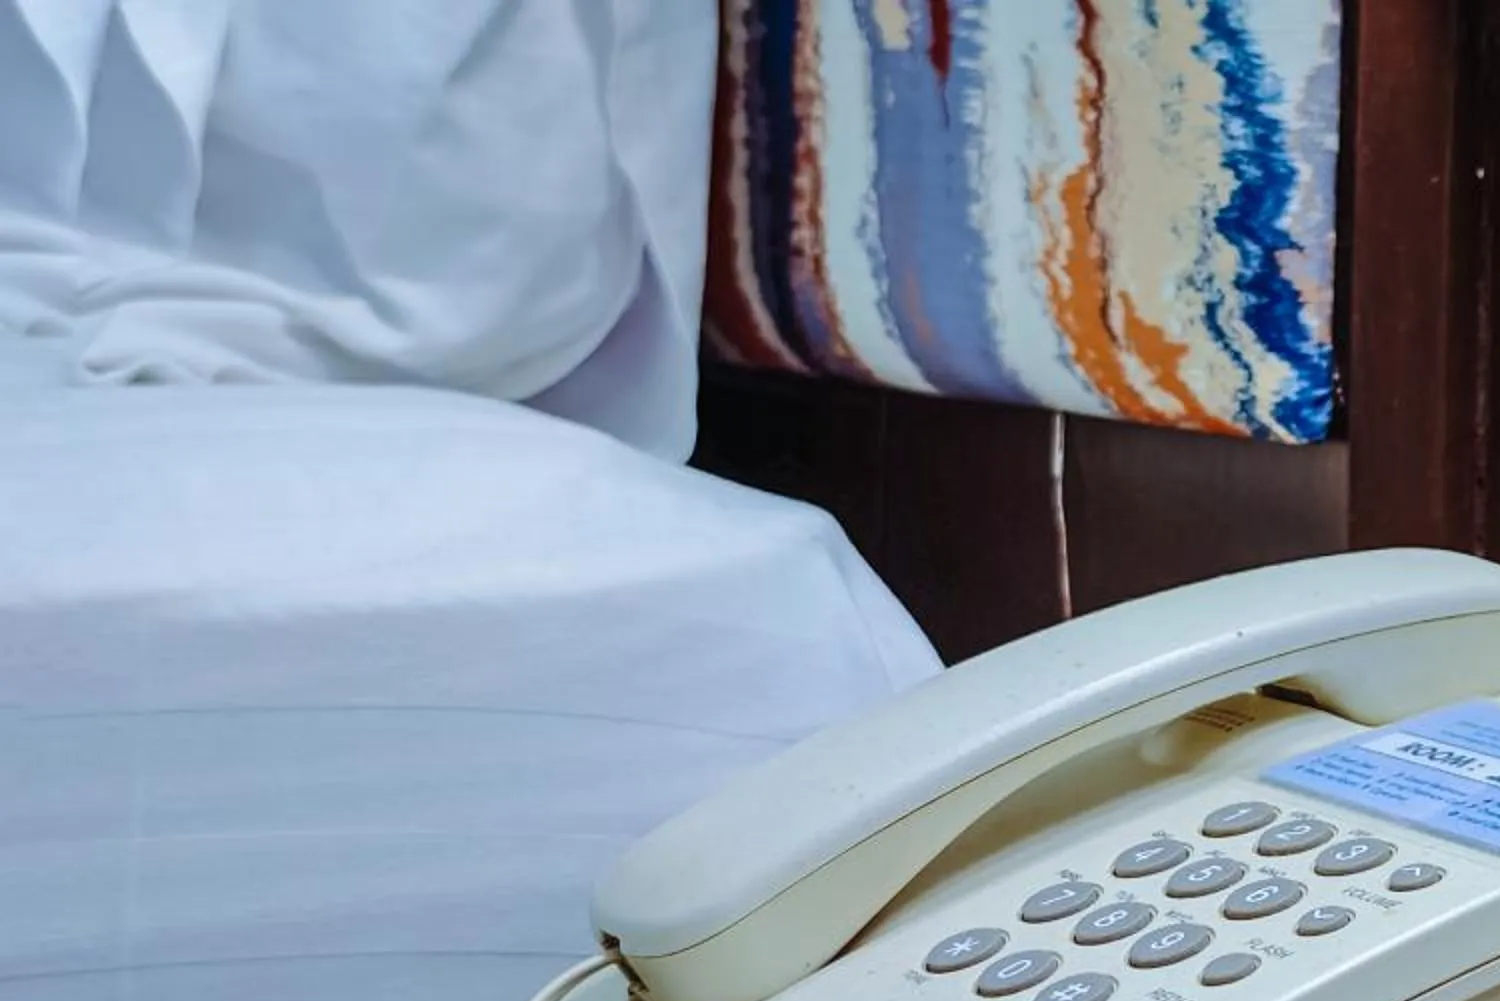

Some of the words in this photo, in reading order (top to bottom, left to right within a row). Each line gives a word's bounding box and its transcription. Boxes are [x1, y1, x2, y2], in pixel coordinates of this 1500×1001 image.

[1223, 807, 1253, 823] 1
[1276, 824, 1312, 841] 2
[1135, 846, 1165, 863] 4
[1335, 844, 1370, 862] 3
[1188, 865, 1223, 882] 5
[1042, 889, 1076, 906] 7
[1246, 884, 1280, 903] 6
[1093, 909, 1129, 928] 8
[1150, 931, 1186, 950] 9
[996, 958, 1032, 980] 0
